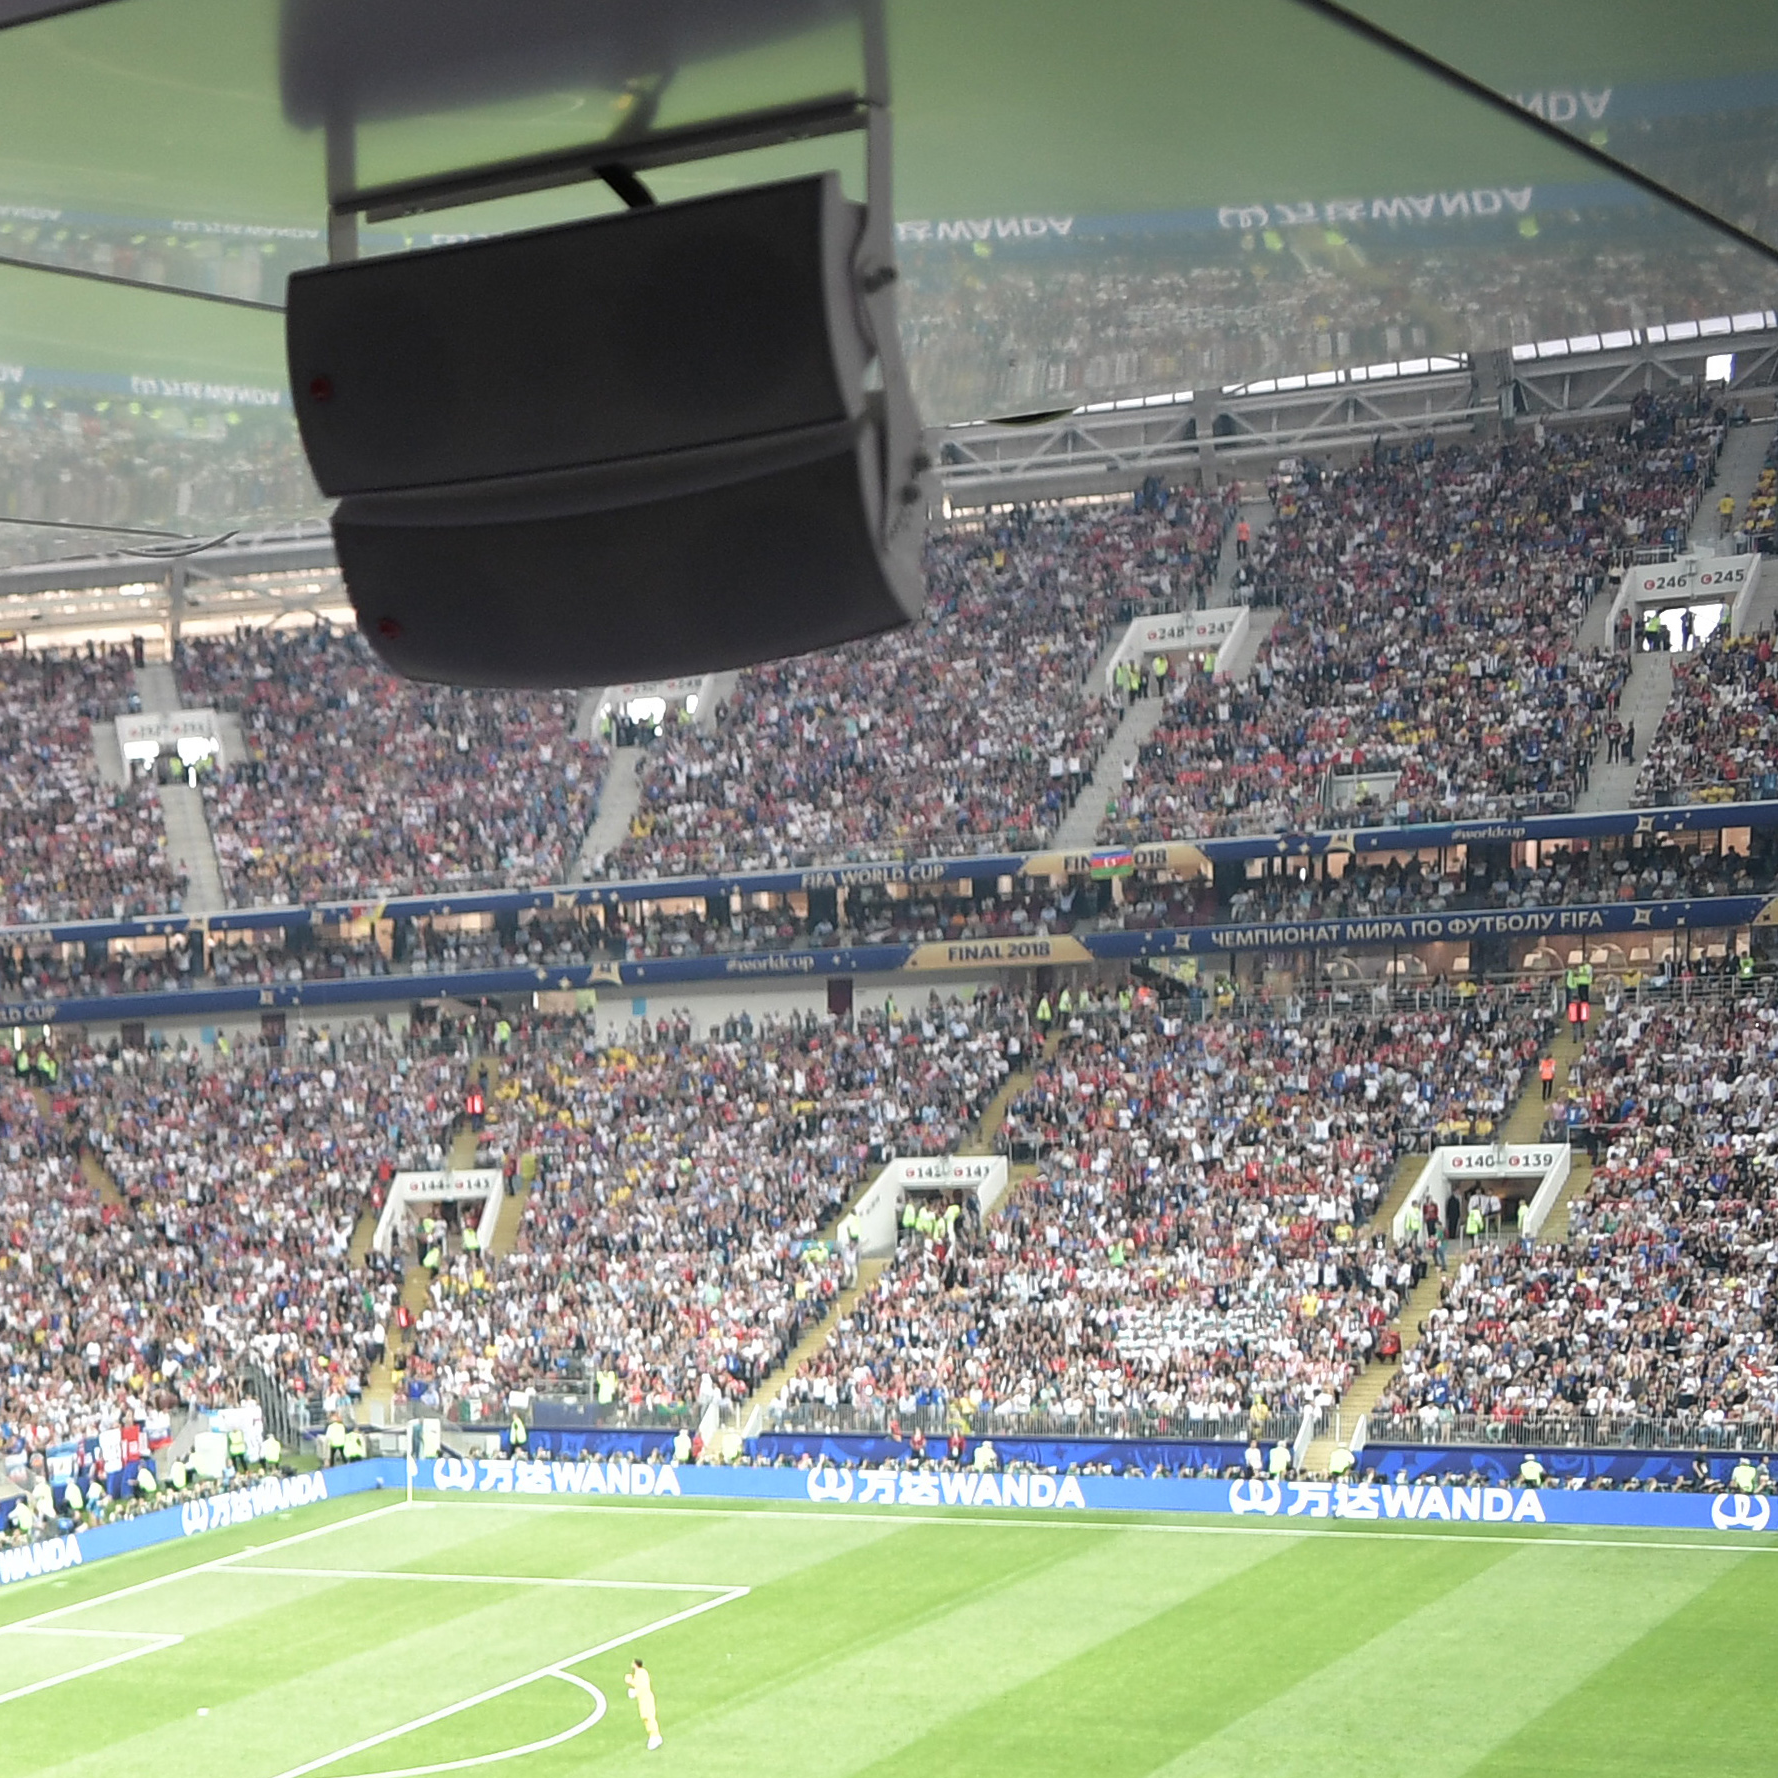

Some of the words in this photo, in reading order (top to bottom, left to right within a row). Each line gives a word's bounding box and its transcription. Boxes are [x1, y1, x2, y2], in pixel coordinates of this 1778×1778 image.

[1656, 575, 1687, 590] 246
[1714, 569, 1745, 584] 245
[801, 871, 837, 888] FIFA
[840, 866, 905, 886] WORLD
[908, 863, 945, 883] CUP
[1211, 924, 1341, 948] ЧЕМПИОНАТ
[1346, 921, 1407, 944] МИРА
[1411, 918, 1443, 939] ПО
[1448, 913, 1554, 937] ФУТБОЛУ
[1560, 911, 1604, 931] FIFA
[948, 945, 1003, 962] FINAL
[1007, 941, 1051, 958] 2018
[726, 953, 815, 973] #worldcup
[1465, 1154, 1496, 1168] 140
[1522, 1153, 1553, 1167] 139
